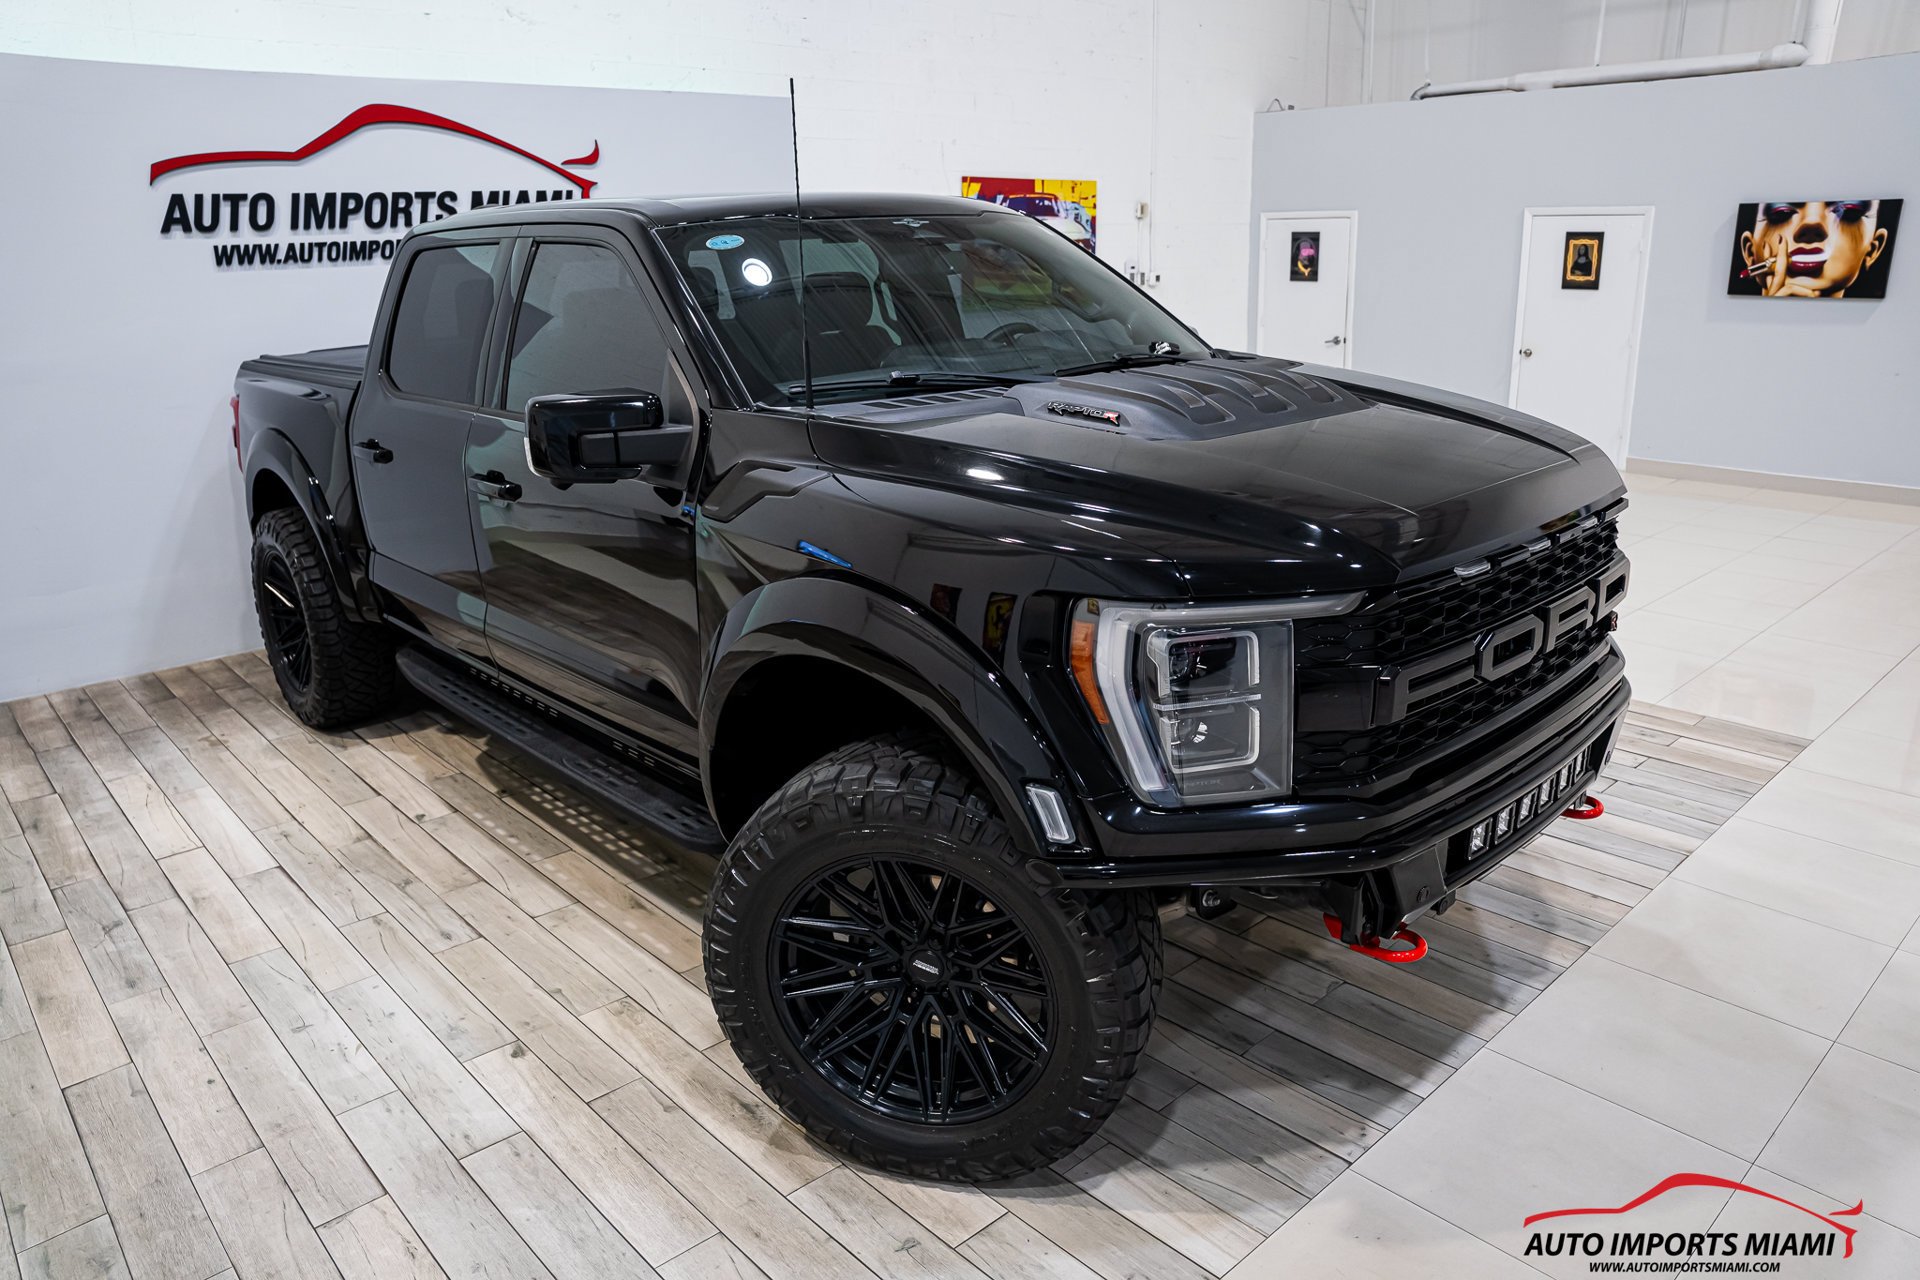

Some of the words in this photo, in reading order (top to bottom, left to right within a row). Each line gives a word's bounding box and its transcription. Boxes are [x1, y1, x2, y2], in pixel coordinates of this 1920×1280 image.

[160, 192, 275, 233] AUTO
[290, 191, 458, 231] IMPORTS
[1378, 549, 1630, 726] FORD
